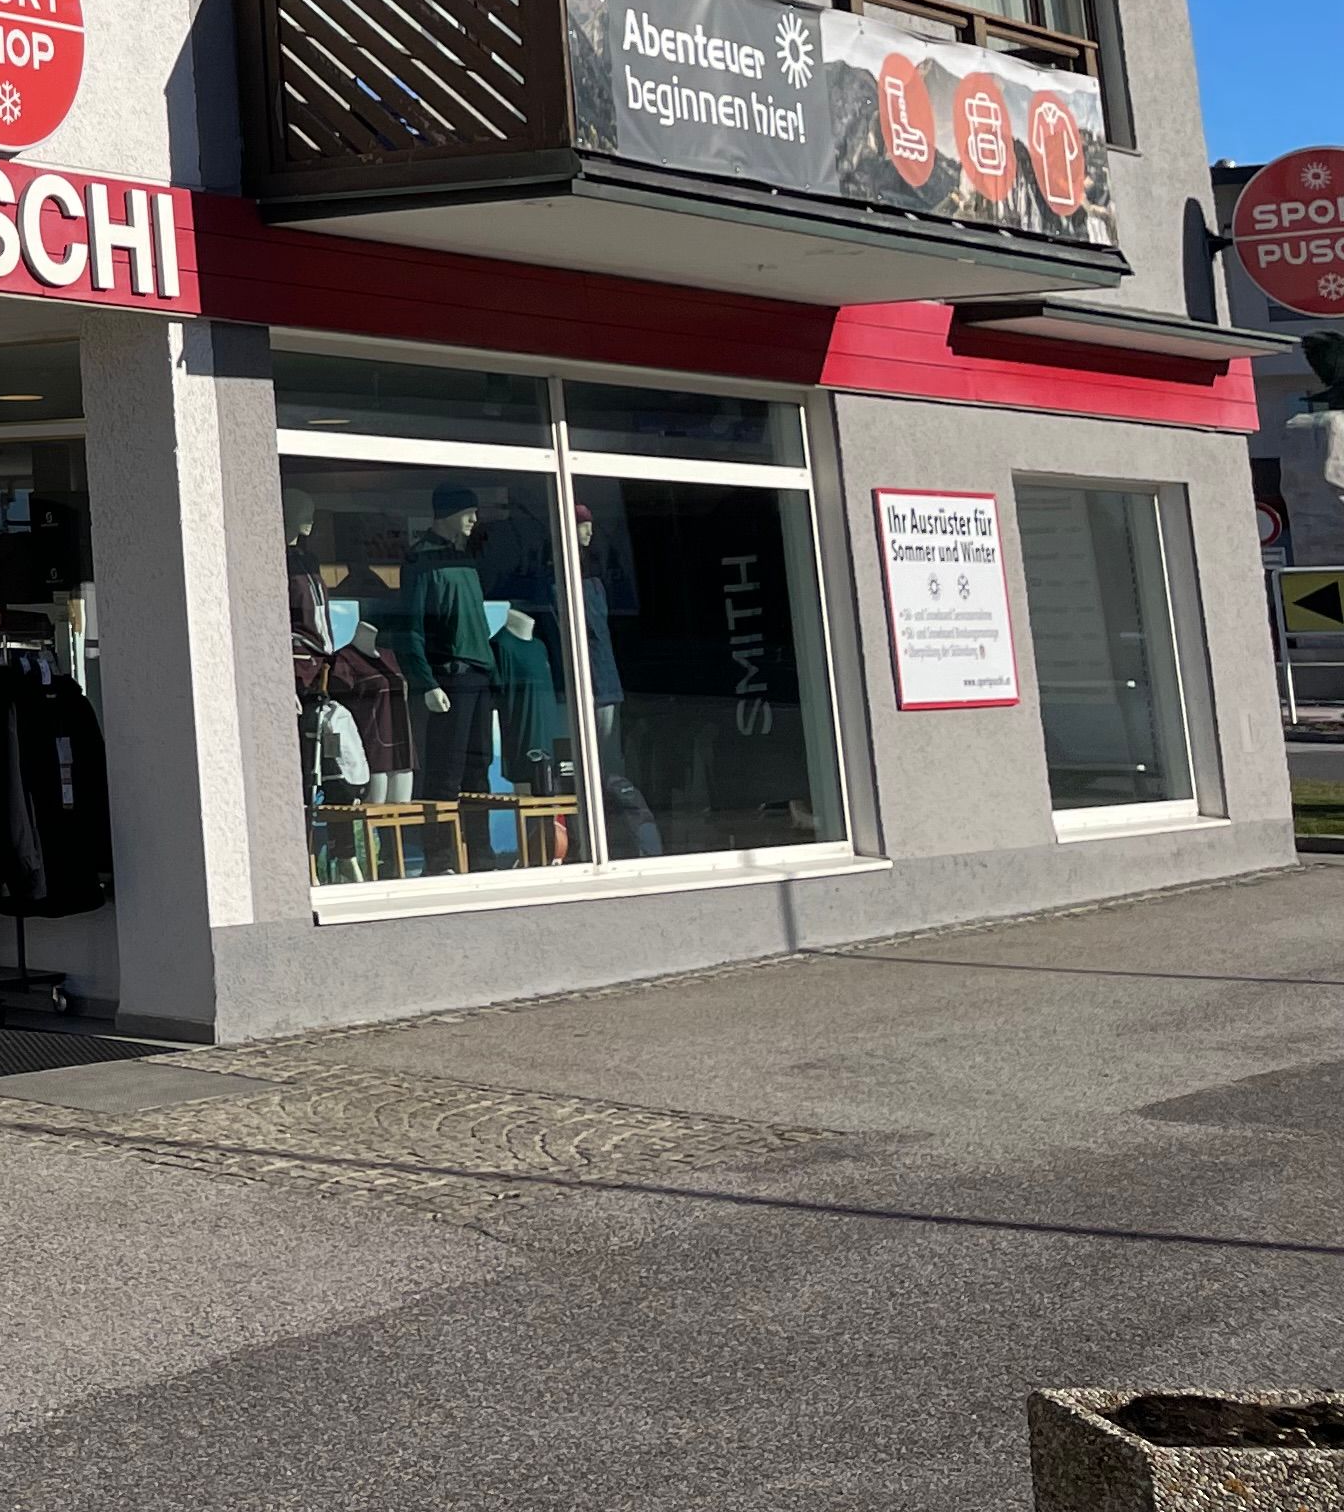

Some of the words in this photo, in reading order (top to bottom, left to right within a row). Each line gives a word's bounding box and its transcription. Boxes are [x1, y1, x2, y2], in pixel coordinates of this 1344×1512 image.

[623, 8, 766, 80] Abenteuer
[623, 64, 750, 131] beginnen
[750, 90, 807, 144] hier!
[887, 505, 907, 534] Ihr
[911, 508, 971, 536] Ausrüster
[974, 508, 993, 537] für
[891, 540, 936, 562] Sommer
[939, 540, 959, 563] und
[961, 541, 996, 563] Winter
[721, 554, 773, 736] SMITH
